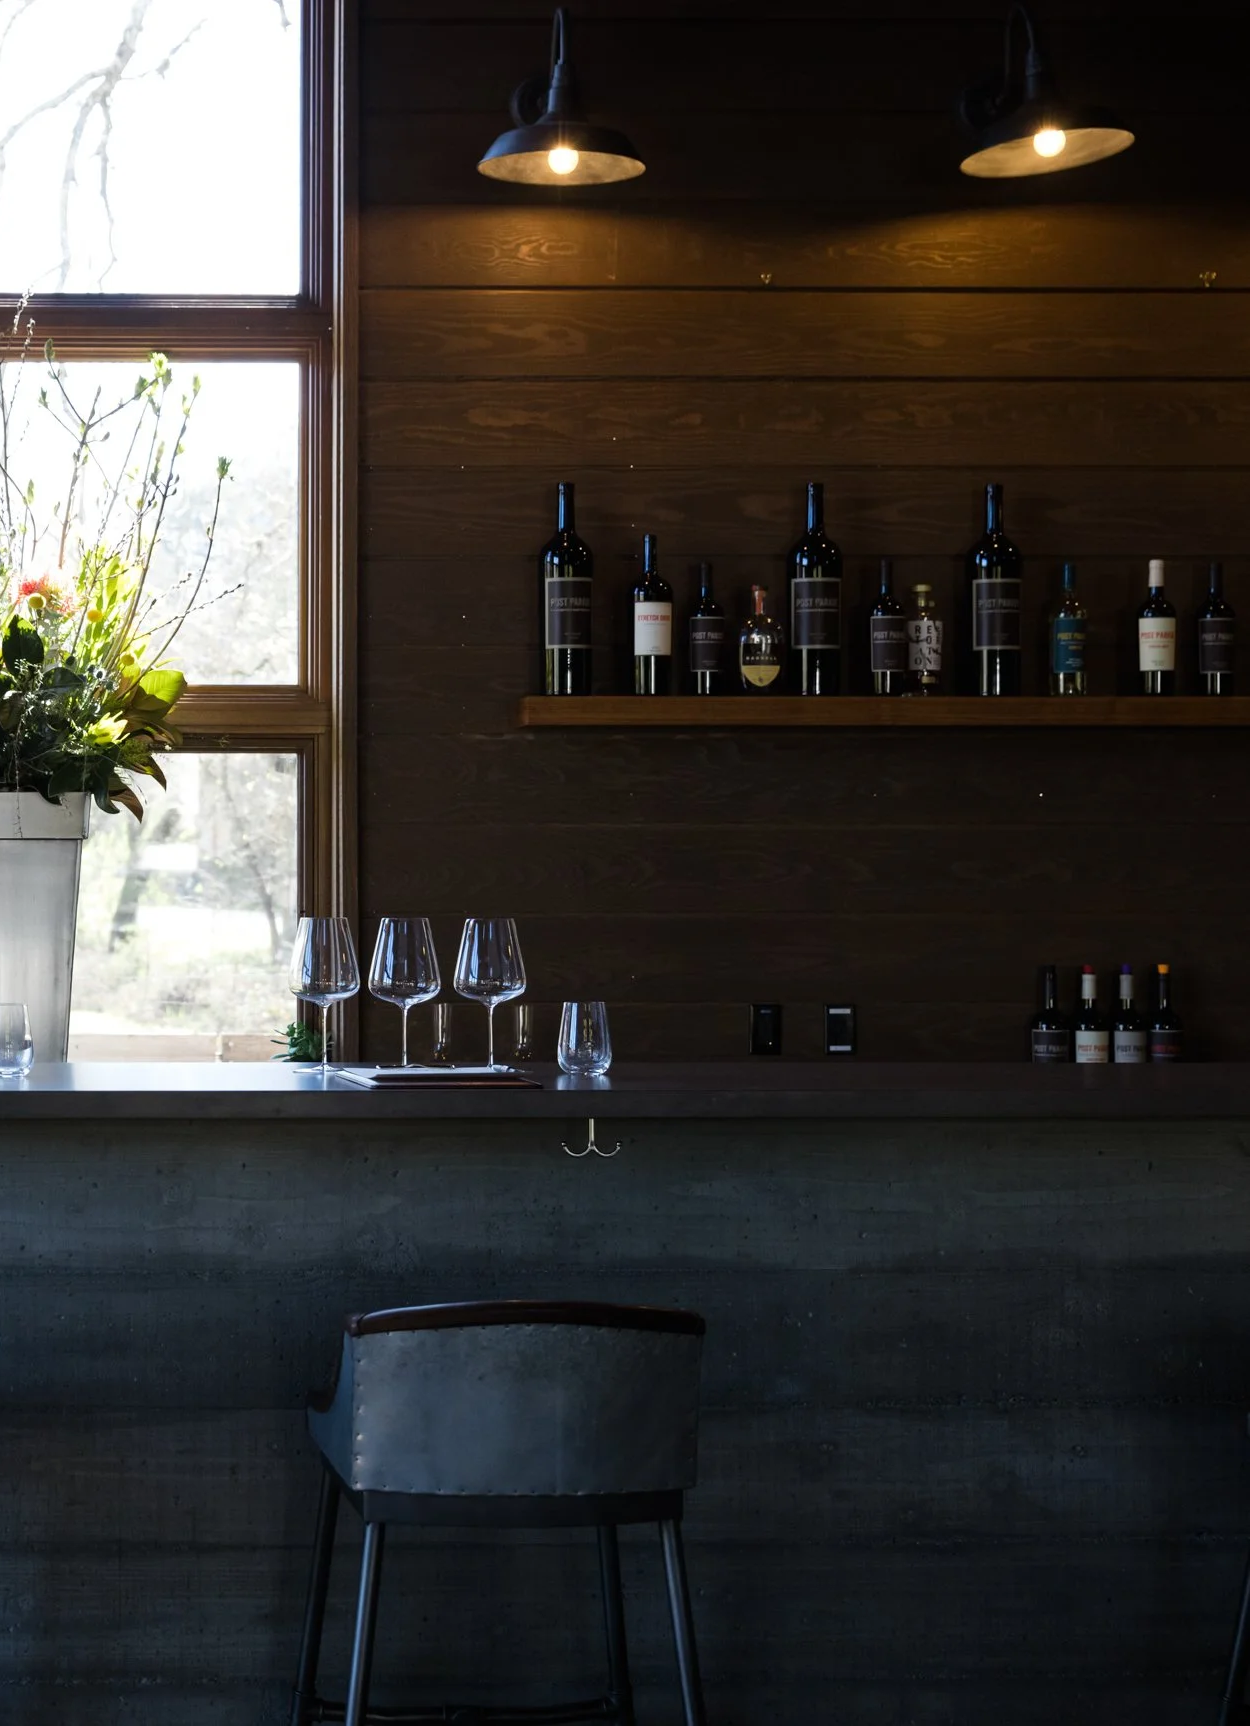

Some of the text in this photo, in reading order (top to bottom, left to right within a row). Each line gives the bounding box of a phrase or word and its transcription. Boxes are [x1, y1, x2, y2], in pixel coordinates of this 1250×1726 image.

[550, 597, 567, 607] POST
[796, 597, 813, 608] POST
[978, 598, 996, 608] POST
[692, 631, 706, 640] POST
[873, 631, 888, 640] POST
